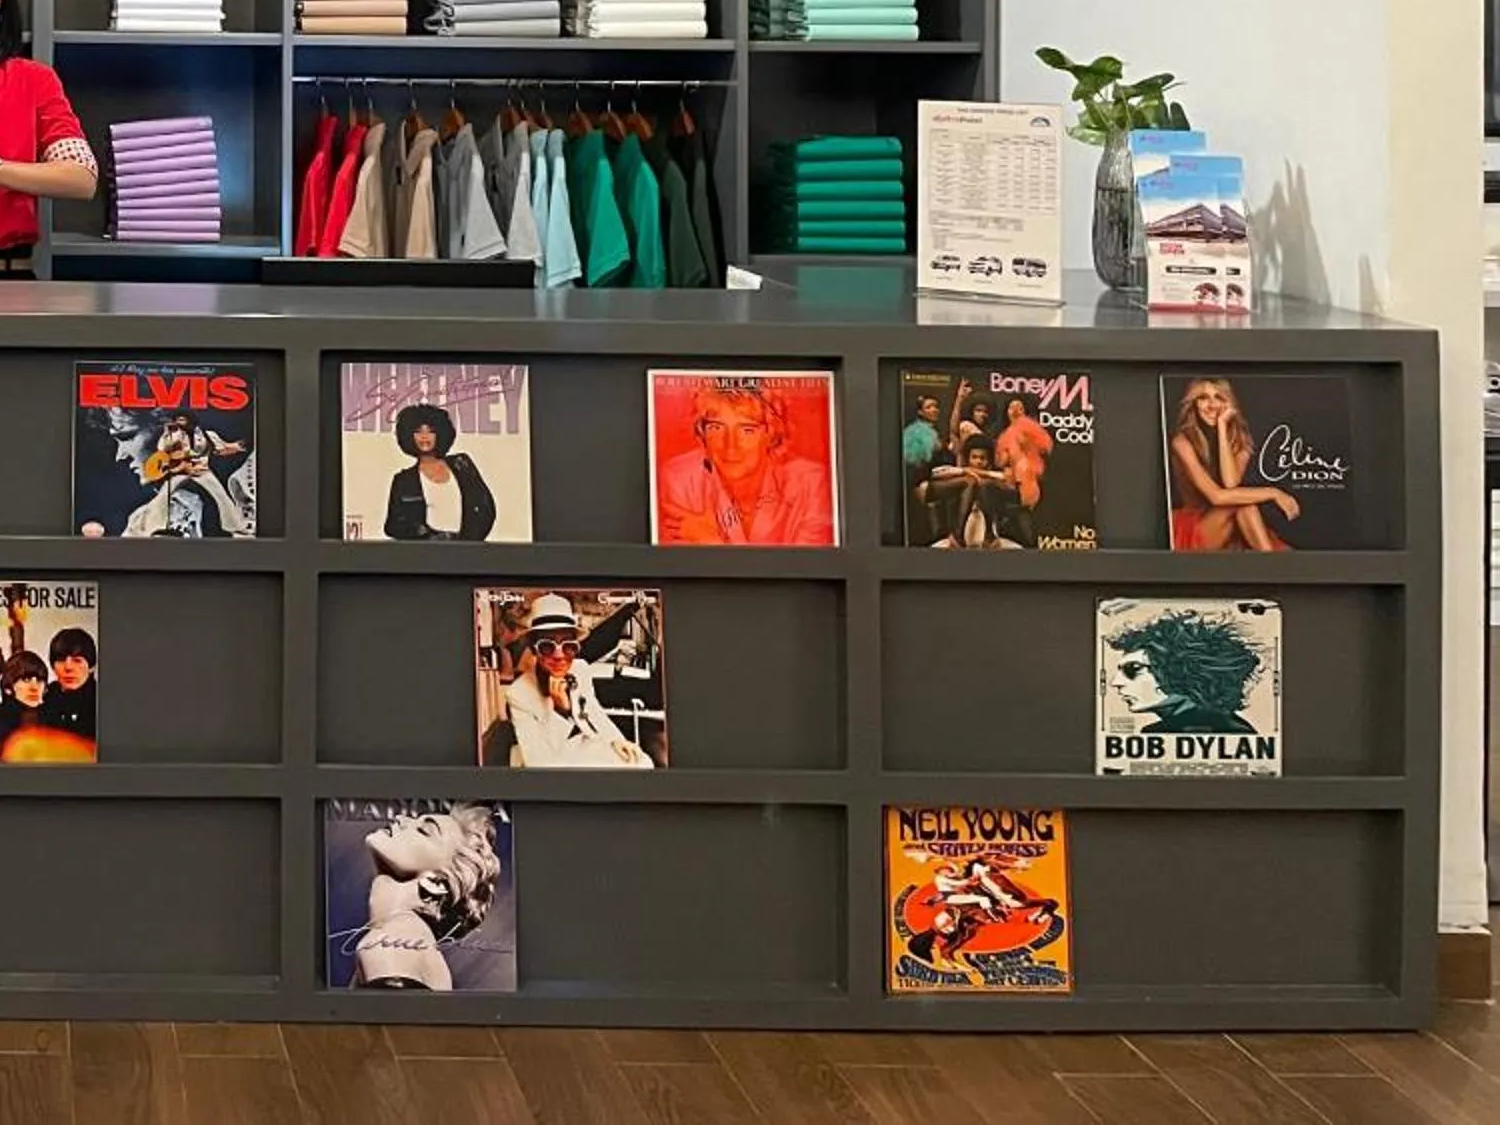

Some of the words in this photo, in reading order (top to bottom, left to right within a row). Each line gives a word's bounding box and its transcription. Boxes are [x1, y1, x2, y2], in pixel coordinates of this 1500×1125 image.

[78, 374, 250, 410] ELVIS
[1039, 412, 1093, 429] Daddy
[1055, 429, 1094, 443] Cool
[1292, 471, 1344, 481] DION
[1073, 524, 1095, 540] No
[55, 587, 96, 609] SALE
[1105, 736, 1165, 759] BOB
[1175, 736, 1276, 760] DYLAN
[901, 810, 960, 841] NEIL
[961, 809, 1054, 841] YOUNG
